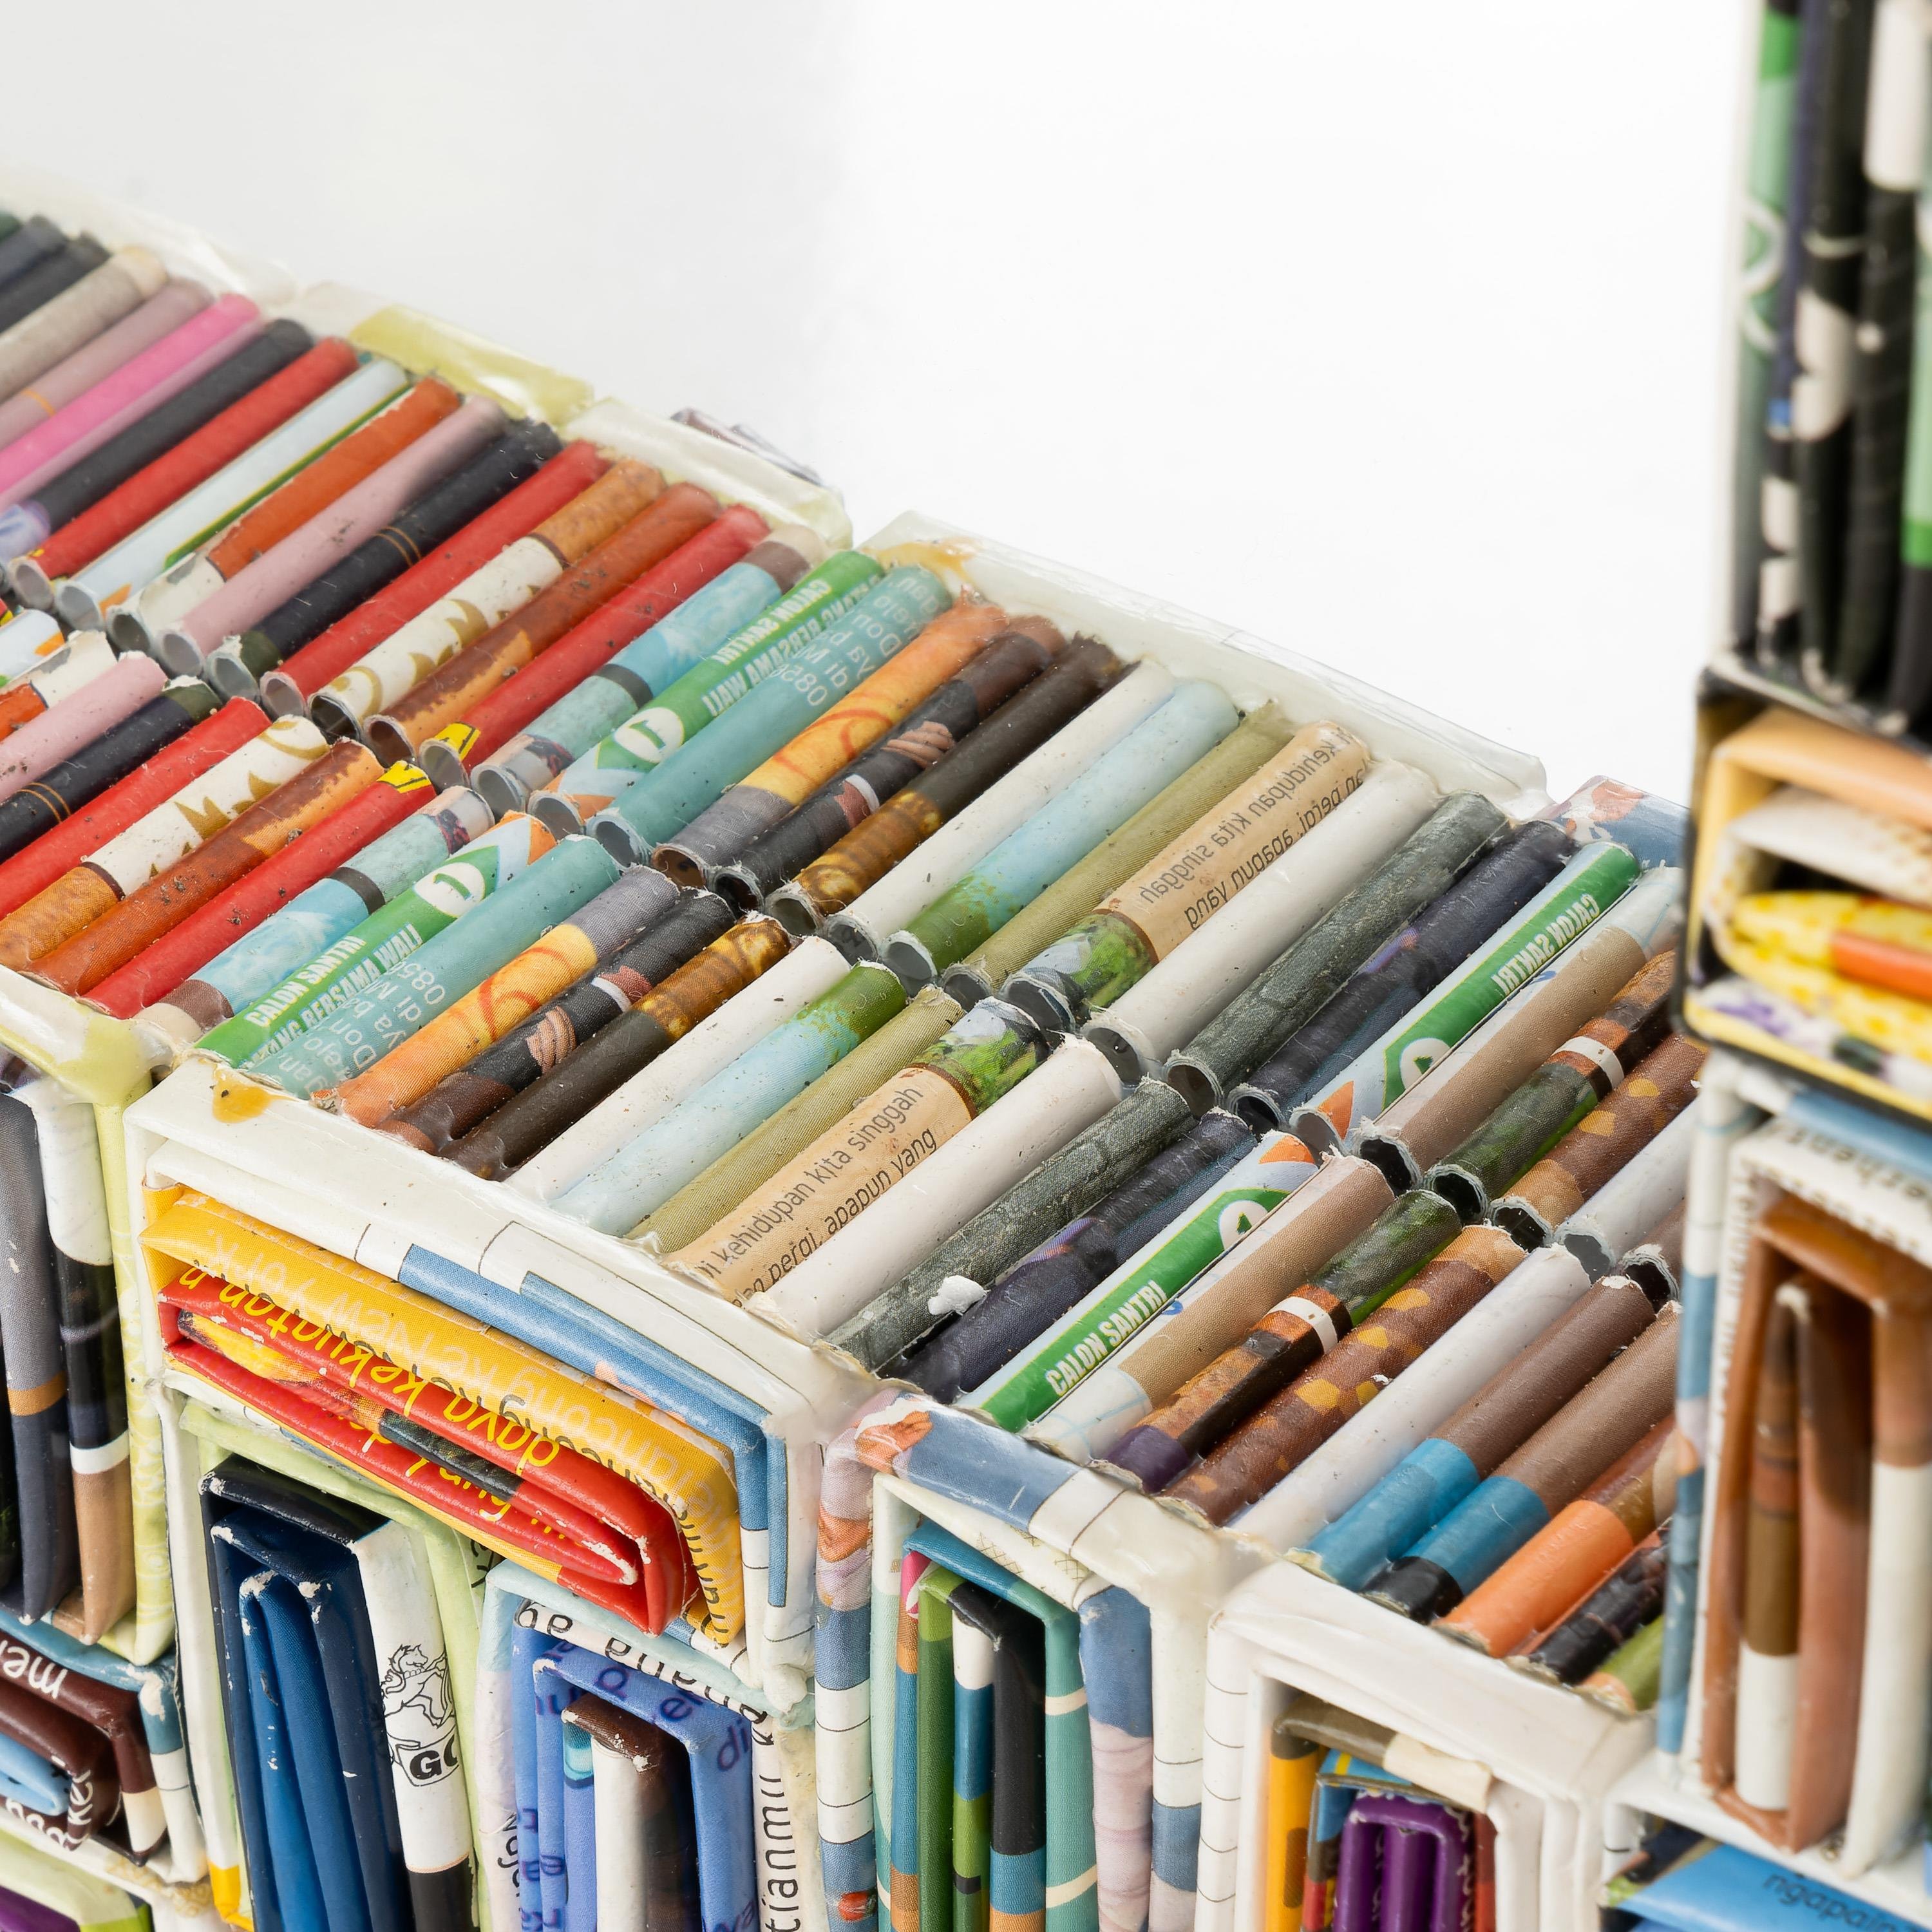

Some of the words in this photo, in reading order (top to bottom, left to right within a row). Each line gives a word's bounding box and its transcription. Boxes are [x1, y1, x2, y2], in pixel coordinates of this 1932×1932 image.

[245, 980, 310, 1028] CALON
[296, 934, 367, 985] SANTRI
[710, 1181, 816, 1265] kehidupan
[804, 1148, 853, 1185] kita
[848, 1086, 924, 1152] singgah
[824, 1170, 892, 1236] apapun
[890, 1128, 937, 1179] yang
[218, 1282, 428, 1417] kekuatan
[1044, 1331, 1108, 1397] CALON
[1097, 1278, 1168, 1348] SANTRI
